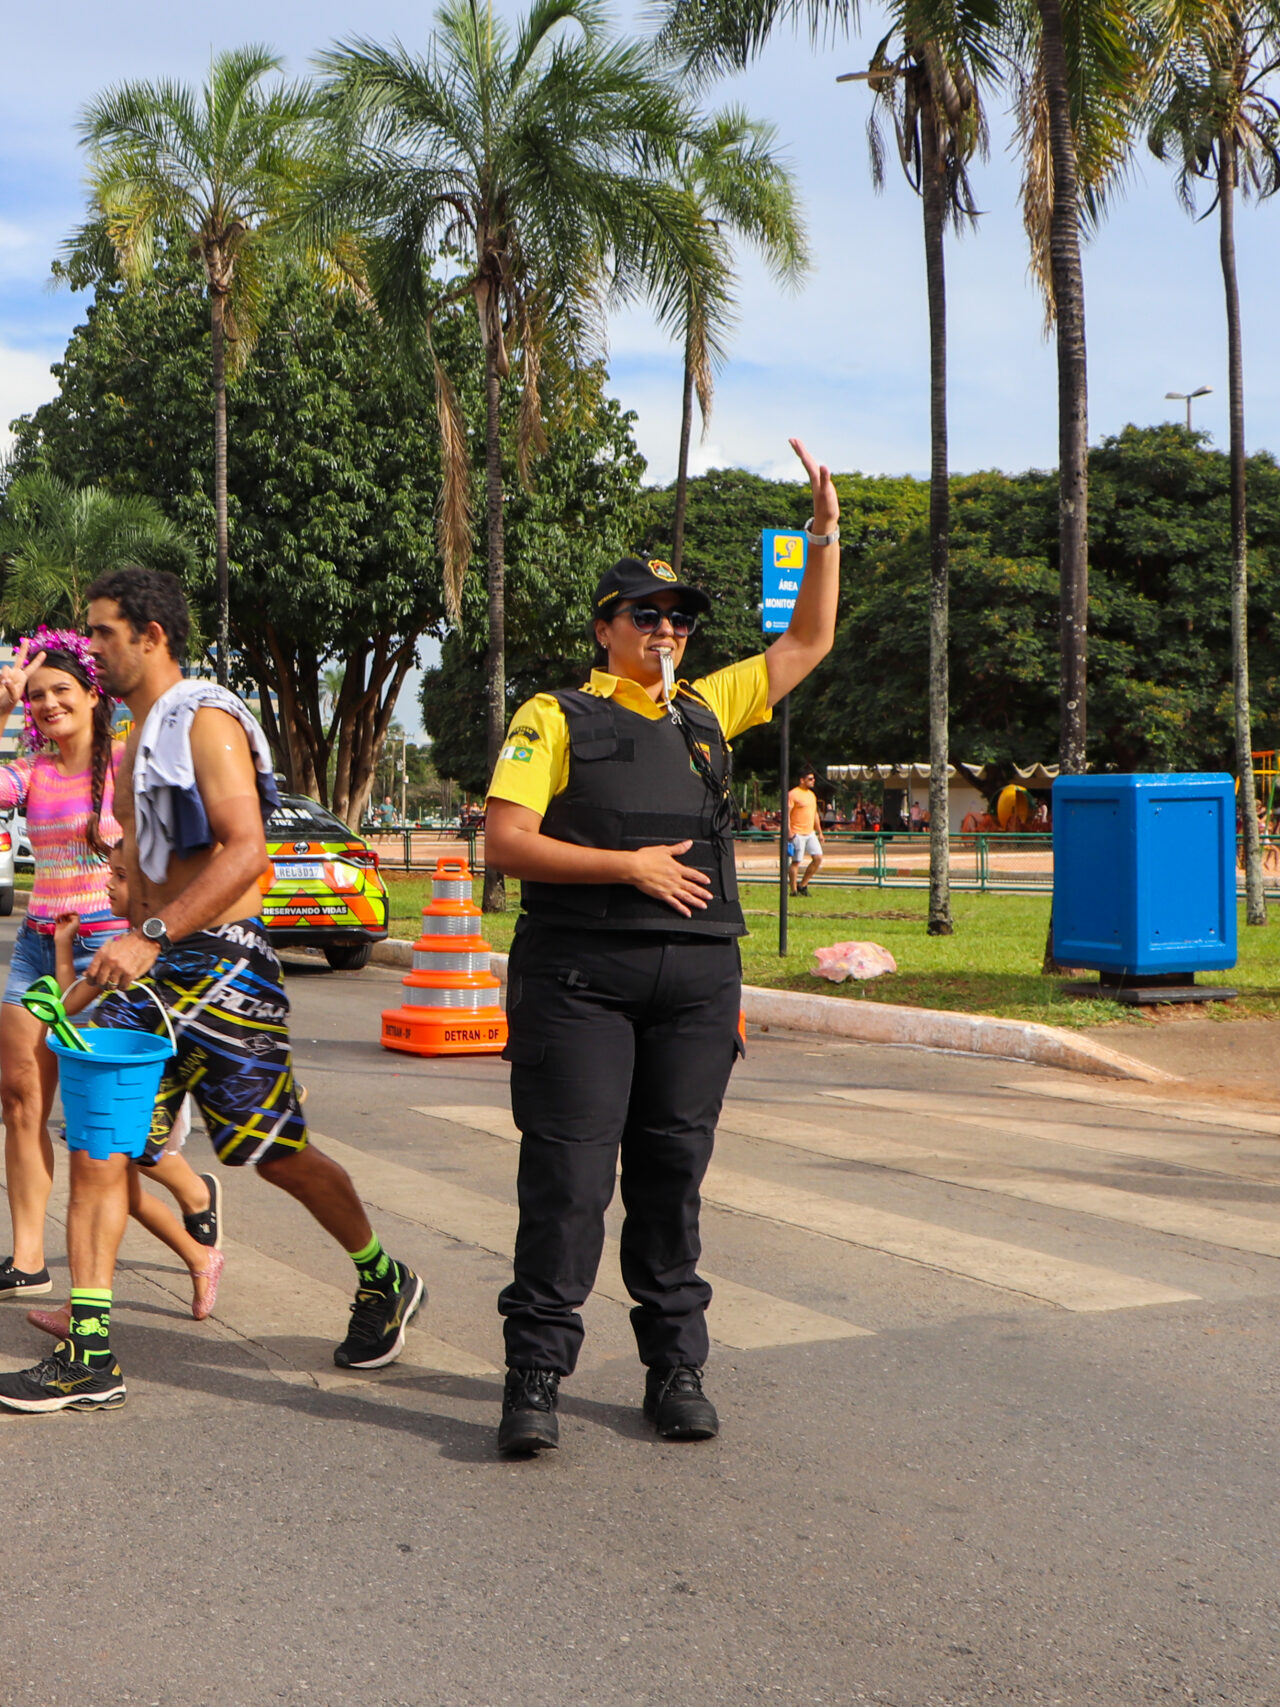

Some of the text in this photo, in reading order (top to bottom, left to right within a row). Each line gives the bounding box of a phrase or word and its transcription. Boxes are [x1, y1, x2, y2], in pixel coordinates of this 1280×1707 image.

[778, 578, 799, 591] ÁREA
[321, 906, 347, 914] VIDAS
[444, 1029, 480, 1041] DETRAN
[488, 1028, 499, 1040] DF
